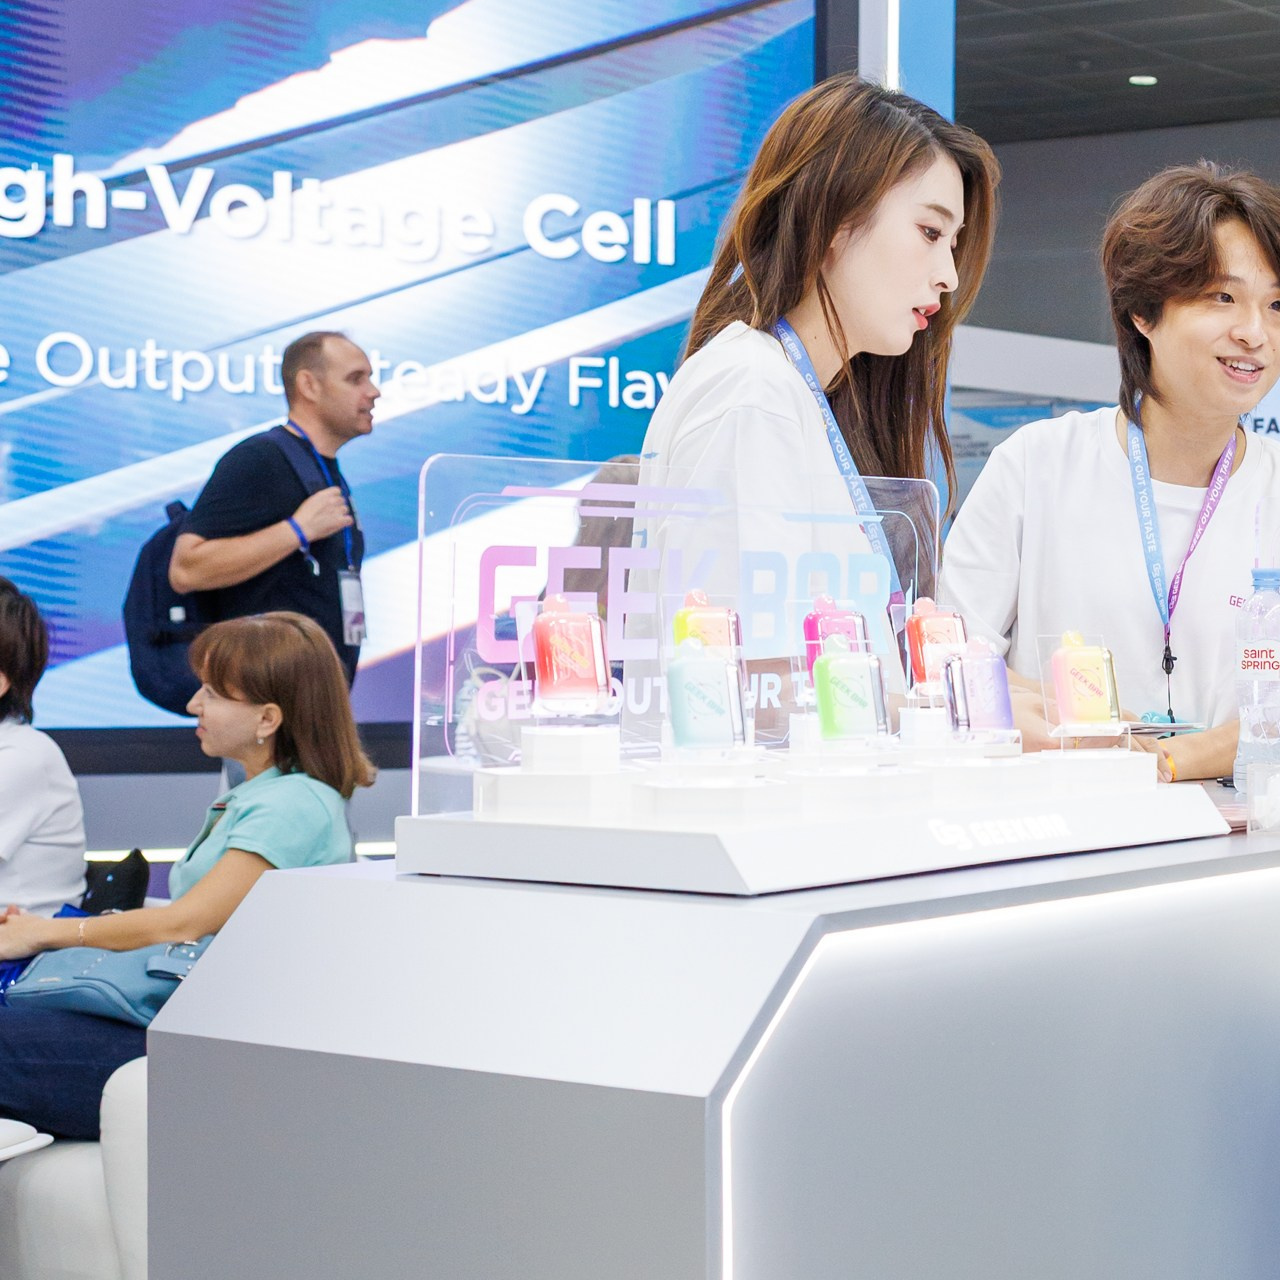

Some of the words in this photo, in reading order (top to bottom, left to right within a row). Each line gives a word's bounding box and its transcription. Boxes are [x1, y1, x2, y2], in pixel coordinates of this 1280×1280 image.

[522, 192, 676, 266] Cell
[370, 349, 547, 415] teady
[822, 407, 837, 433] OUT
[832, 436, 851, 471] YOUR
[848, 472, 868, 512] TASTE
[1131, 436, 1142, 463] GEEK
[1135, 464, 1146, 487] OUT
[1200, 503, 1213, 525] OUT
[1209, 476, 1225, 503] YOUR
[1220, 447, 1233, 475] TASTE
[1139, 488, 1151, 518] YOUR
[1144, 519, 1157, 553] TASTE
[1069, 667, 1090, 689] GEEK
[1087, 681, 1104, 698] BAR
